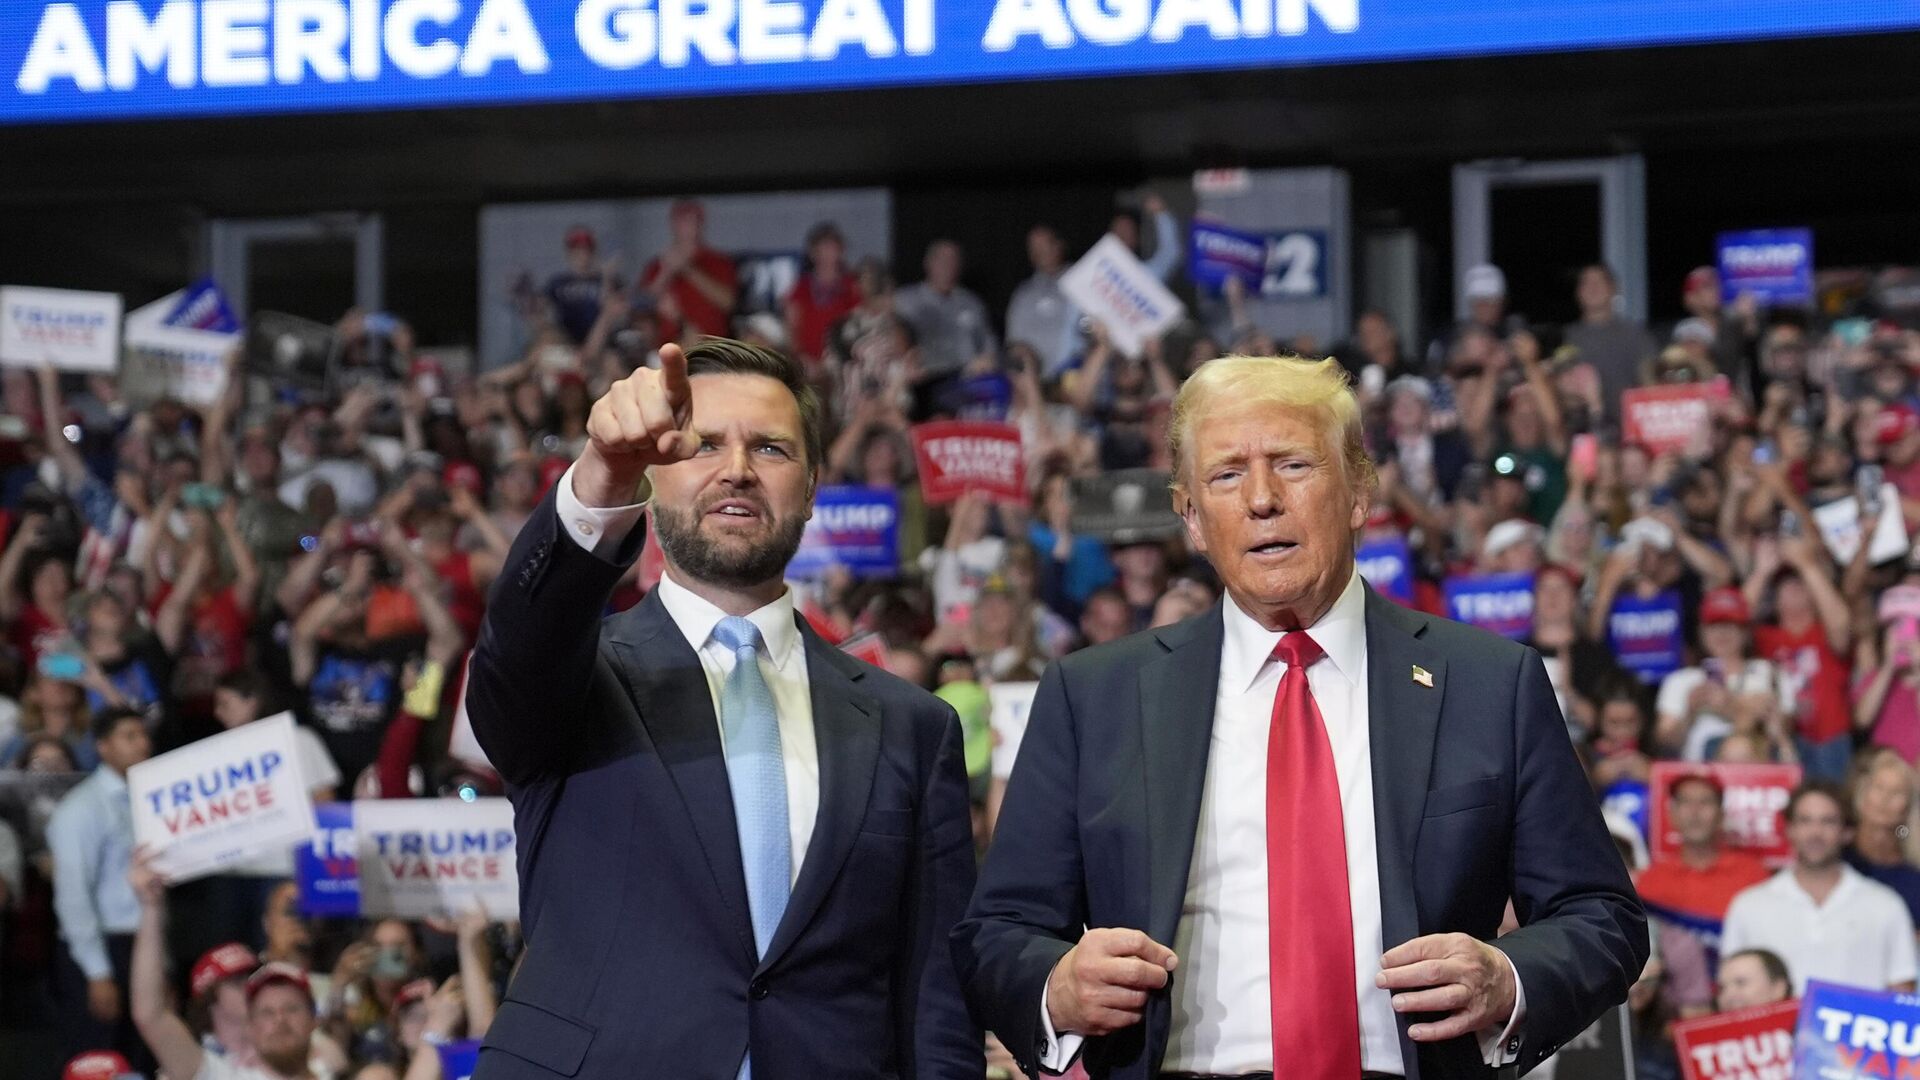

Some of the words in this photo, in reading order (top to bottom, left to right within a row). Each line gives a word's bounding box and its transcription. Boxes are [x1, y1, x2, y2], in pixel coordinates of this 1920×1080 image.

[17, 0, 549, 93] AMERICA
[922, 436, 1018, 460] TRUMP
[937, 455, 1014, 480] VANCE
[145, 751, 283, 815] TRUMP
[163, 782, 275, 836] VANCE
[371, 828, 514, 857] TRUMP
[388, 854, 500, 880] VANCE
